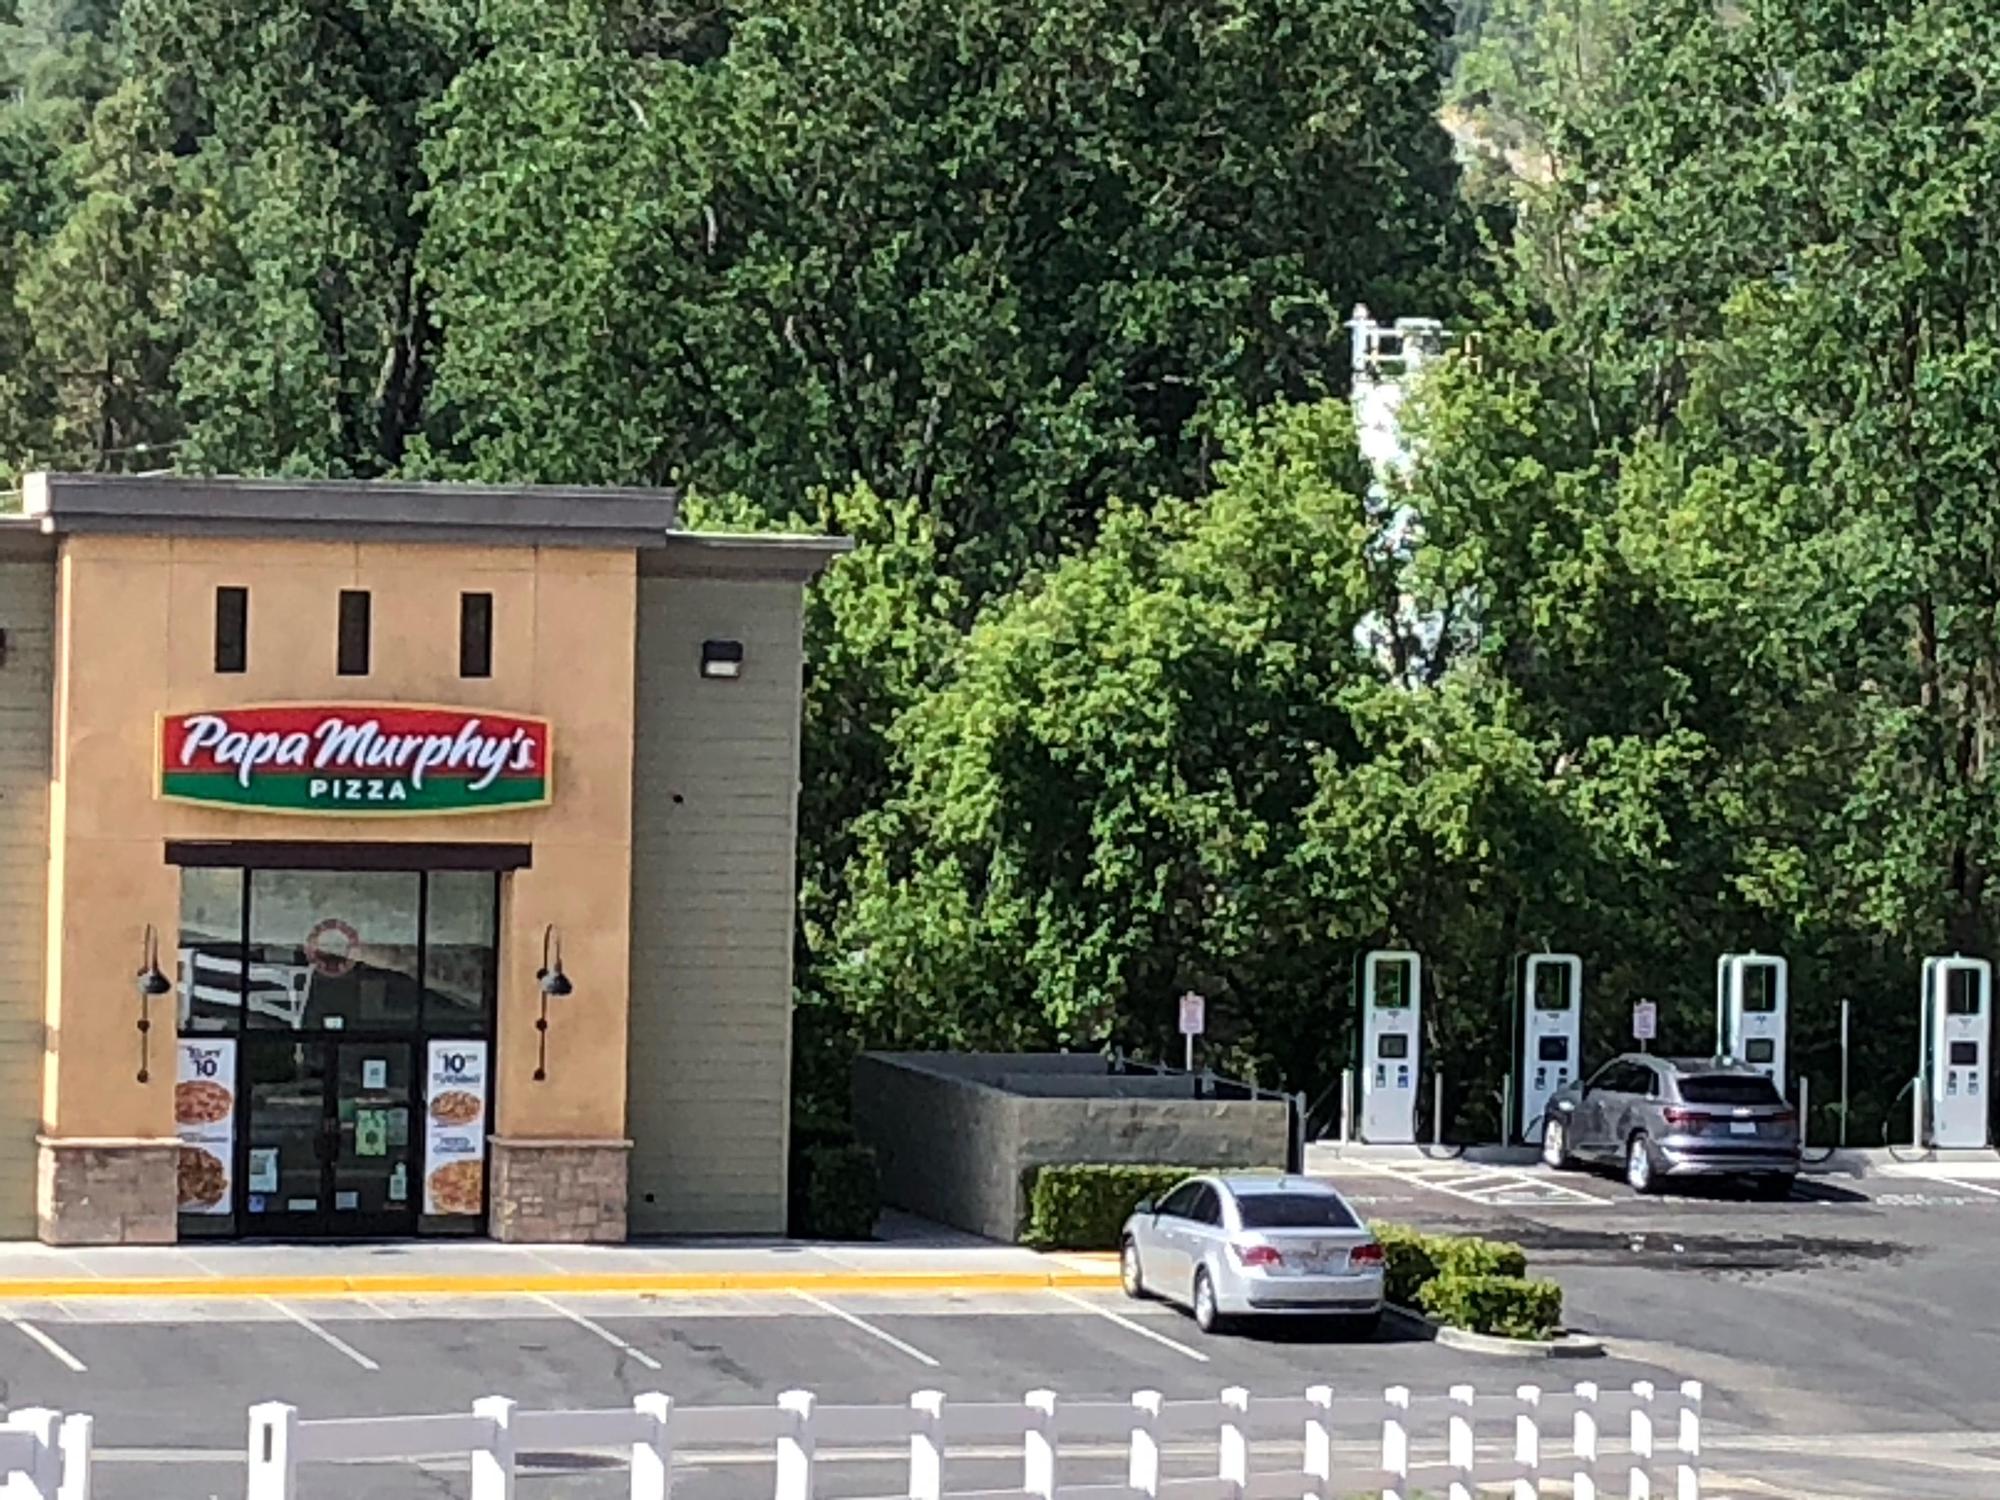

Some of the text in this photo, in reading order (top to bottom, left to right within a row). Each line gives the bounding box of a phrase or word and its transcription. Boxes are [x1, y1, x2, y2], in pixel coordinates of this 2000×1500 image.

[179, 714, 535, 791] Papa Murphy's
[310, 778, 407, 800] PIZZA
[442, 1053, 466, 1073] 10
